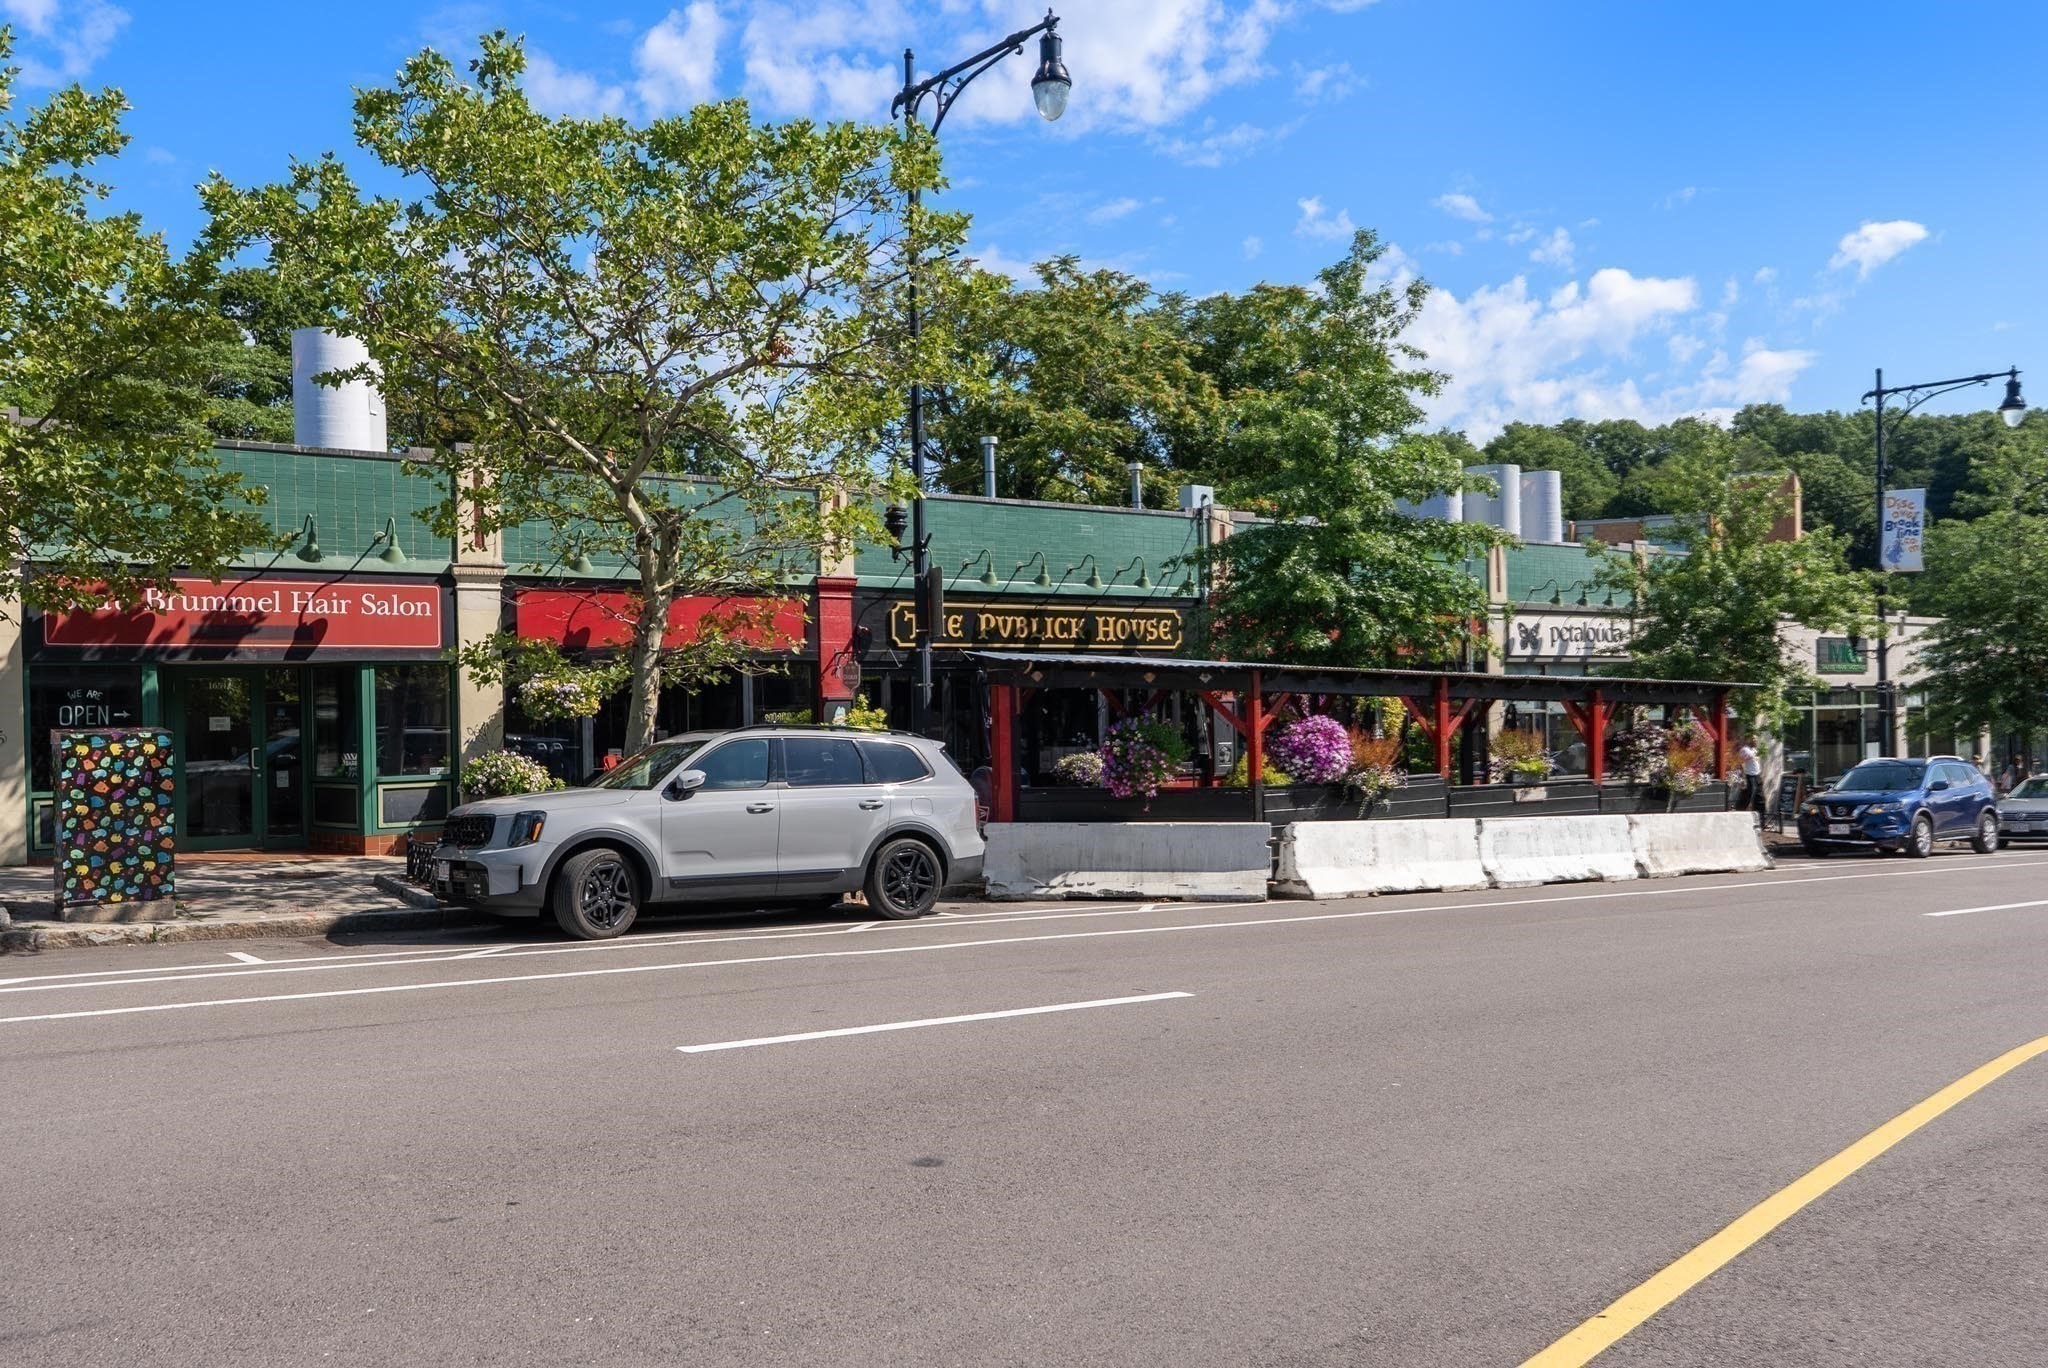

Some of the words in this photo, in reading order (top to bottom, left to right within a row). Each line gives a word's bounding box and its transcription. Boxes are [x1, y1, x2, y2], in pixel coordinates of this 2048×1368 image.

[1884, 519, 1920, 531] Brook
[144, 587, 281, 613] Brummel
[291, 591, 351, 615] Hair
[361, 593, 432, 617] Salon
[903, 610, 963, 638] TE
[67, 689, 82, 700] WE
[86, 689, 104, 701] ARE
[59, 705, 109, 726] OPEN
